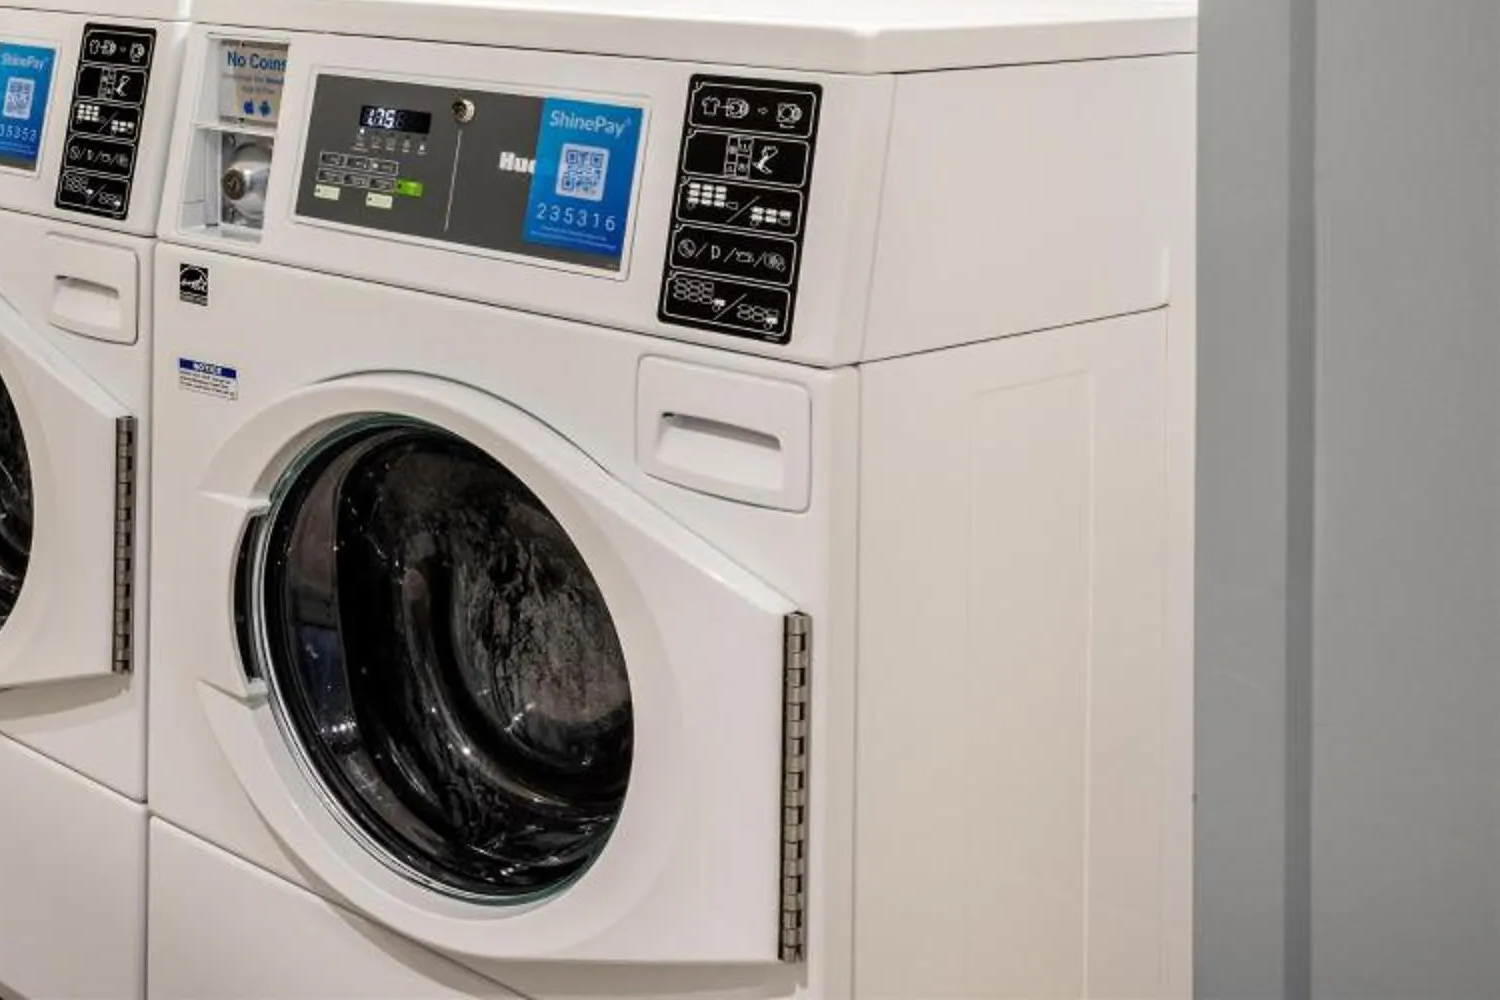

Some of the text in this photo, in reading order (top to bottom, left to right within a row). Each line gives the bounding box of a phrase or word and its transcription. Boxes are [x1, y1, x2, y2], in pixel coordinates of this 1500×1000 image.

[227, 50, 247, 68] No
[549, 108, 627, 141] ShinePay
[535, 201, 617, 232] 235316
